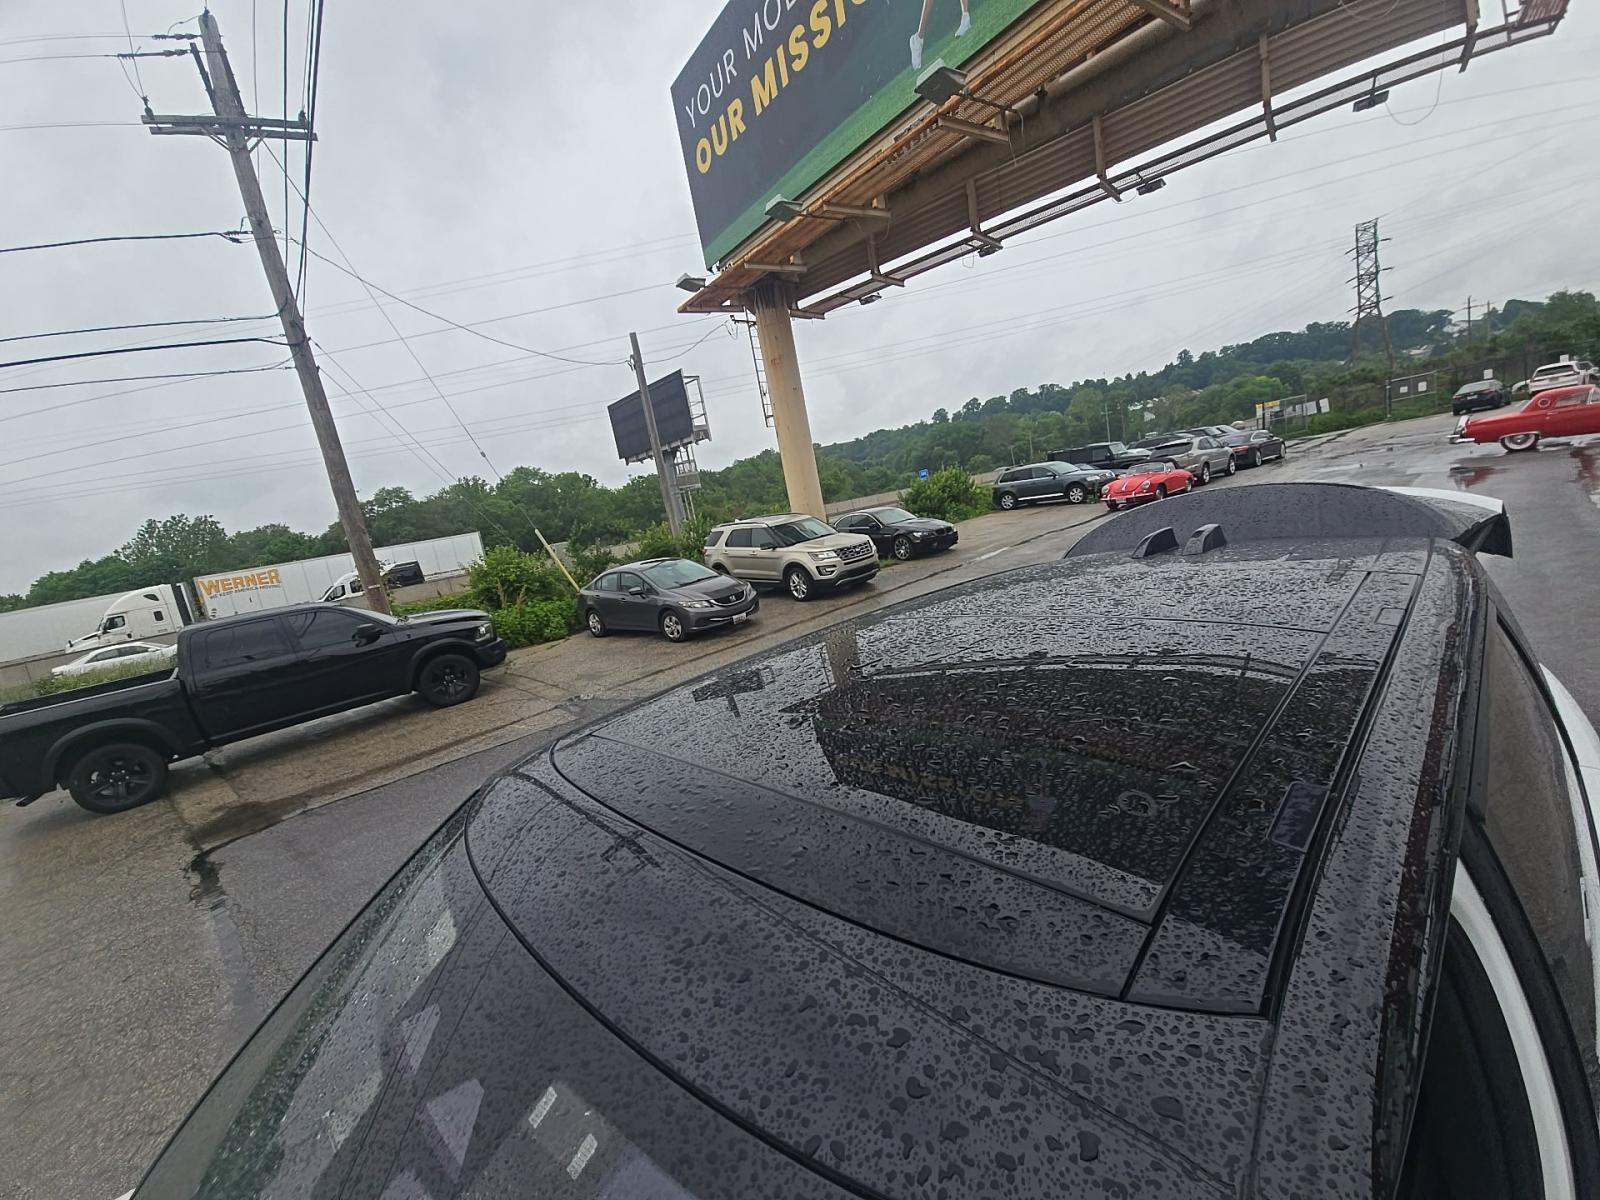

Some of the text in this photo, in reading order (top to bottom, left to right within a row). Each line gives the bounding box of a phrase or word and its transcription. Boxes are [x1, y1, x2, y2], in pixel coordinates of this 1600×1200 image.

[685, 48, 738, 128] YOUR
[696, 0, 866, 174] OUR MISSI
[198, 568, 281, 596] WERNER
